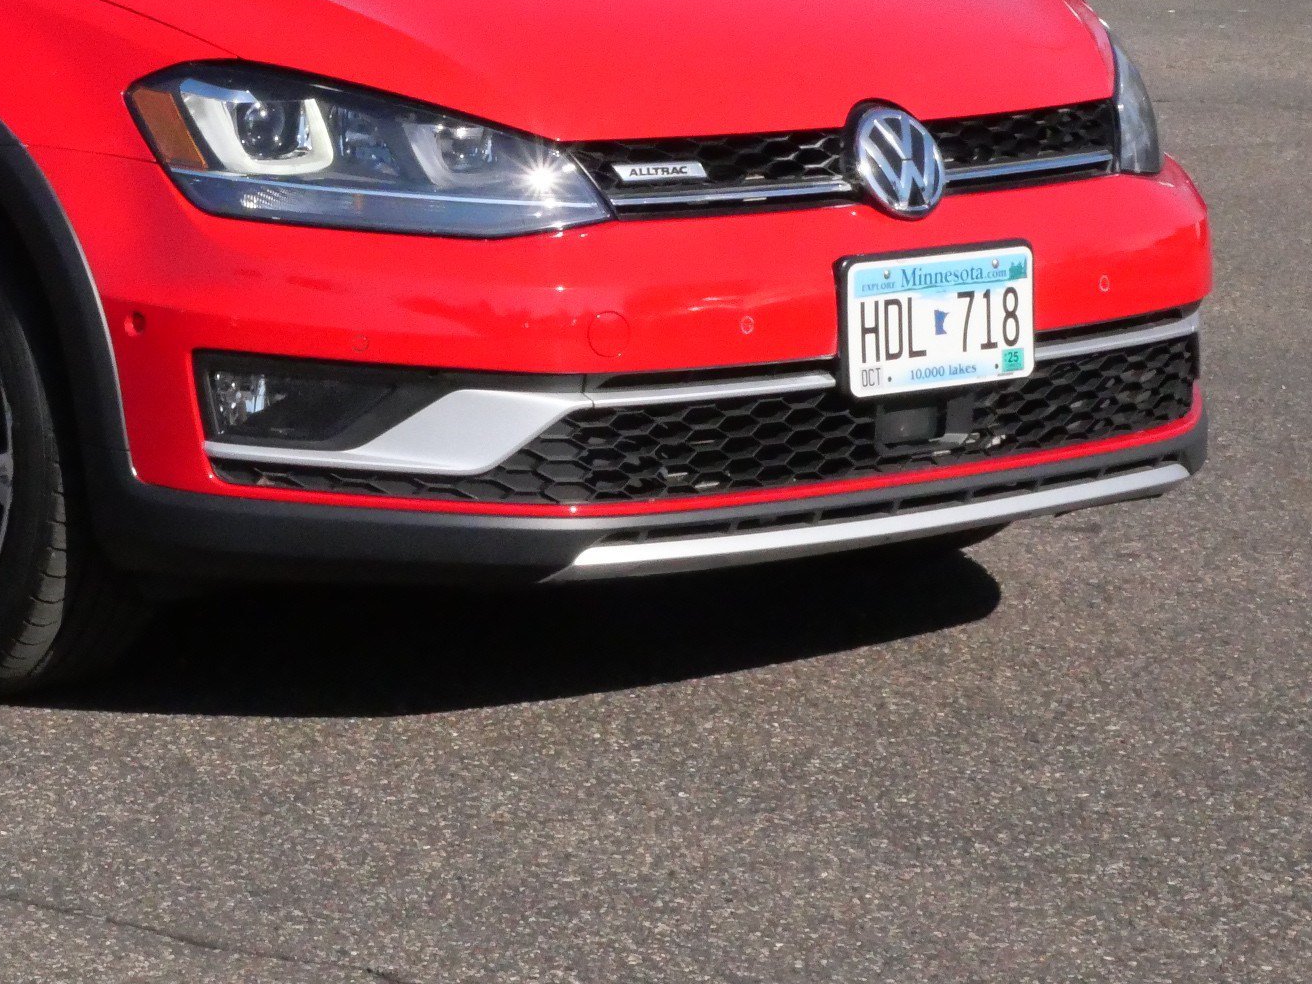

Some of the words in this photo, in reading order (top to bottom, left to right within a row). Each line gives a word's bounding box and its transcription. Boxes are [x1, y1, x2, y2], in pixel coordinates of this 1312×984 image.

[629, 166, 688, 177] ALLTRAC
[861, 282, 896, 292] EXPLORE
[860, 297, 927, 363] HDL
[957, 287, 1020, 352] 718
[1008, 352, 1020, 363] 25
[861, 368, 881, 388] OCT
[910, 365, 945, 380] 10,000
[948, 362, 977, 376] lakes
